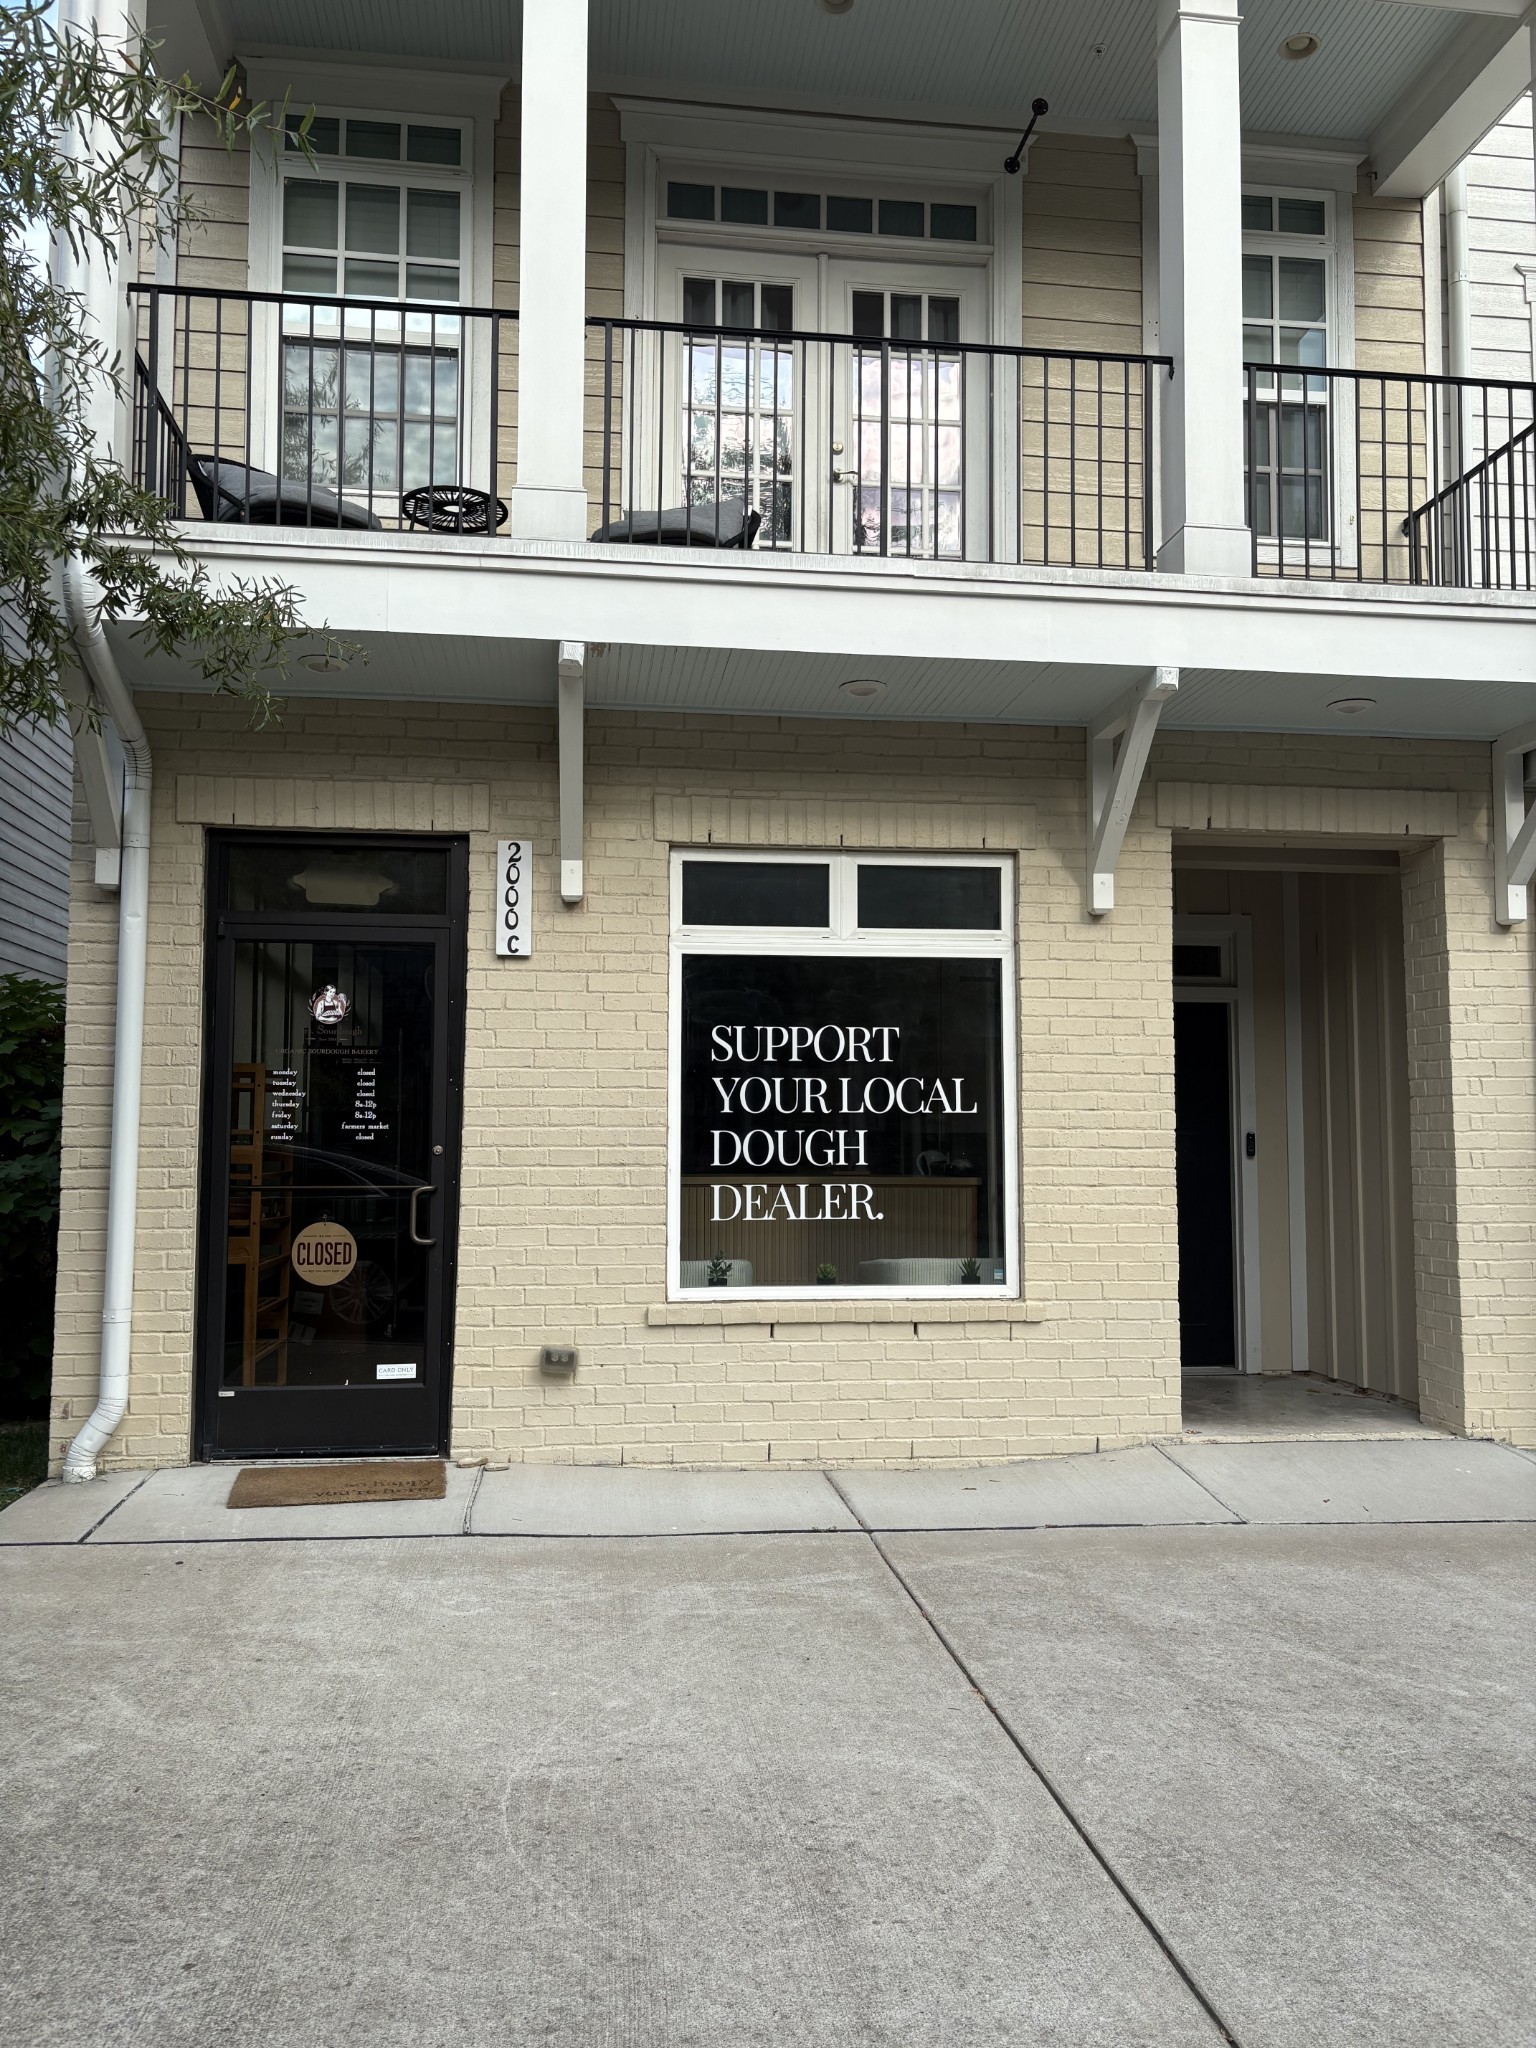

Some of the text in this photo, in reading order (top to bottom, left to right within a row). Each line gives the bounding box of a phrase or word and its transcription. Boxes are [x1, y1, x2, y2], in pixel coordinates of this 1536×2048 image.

[711, 1024, 900, 1063] SUPPORT
[272, 1068, 376, 1077] monday closed
[272, 1079, 376, 1087] tuesday closed
[272, 1089, 375, 1098] wednesday closed
[711, 1076, 978, 1114] YOUR LOCAL
[271, 1100, 300, 1109] thursday
[271, 1110, 292, 1119] friday
[270, 1121, 390, 1130] saturday farmers market
[270, 1132, 375, 1141] sunday closed
[710, 1129, 868, 1167] DOUGH
[710, 1183, 884, 1221] DEALER.
[297, 1241, 352, 1266] CLOSED
